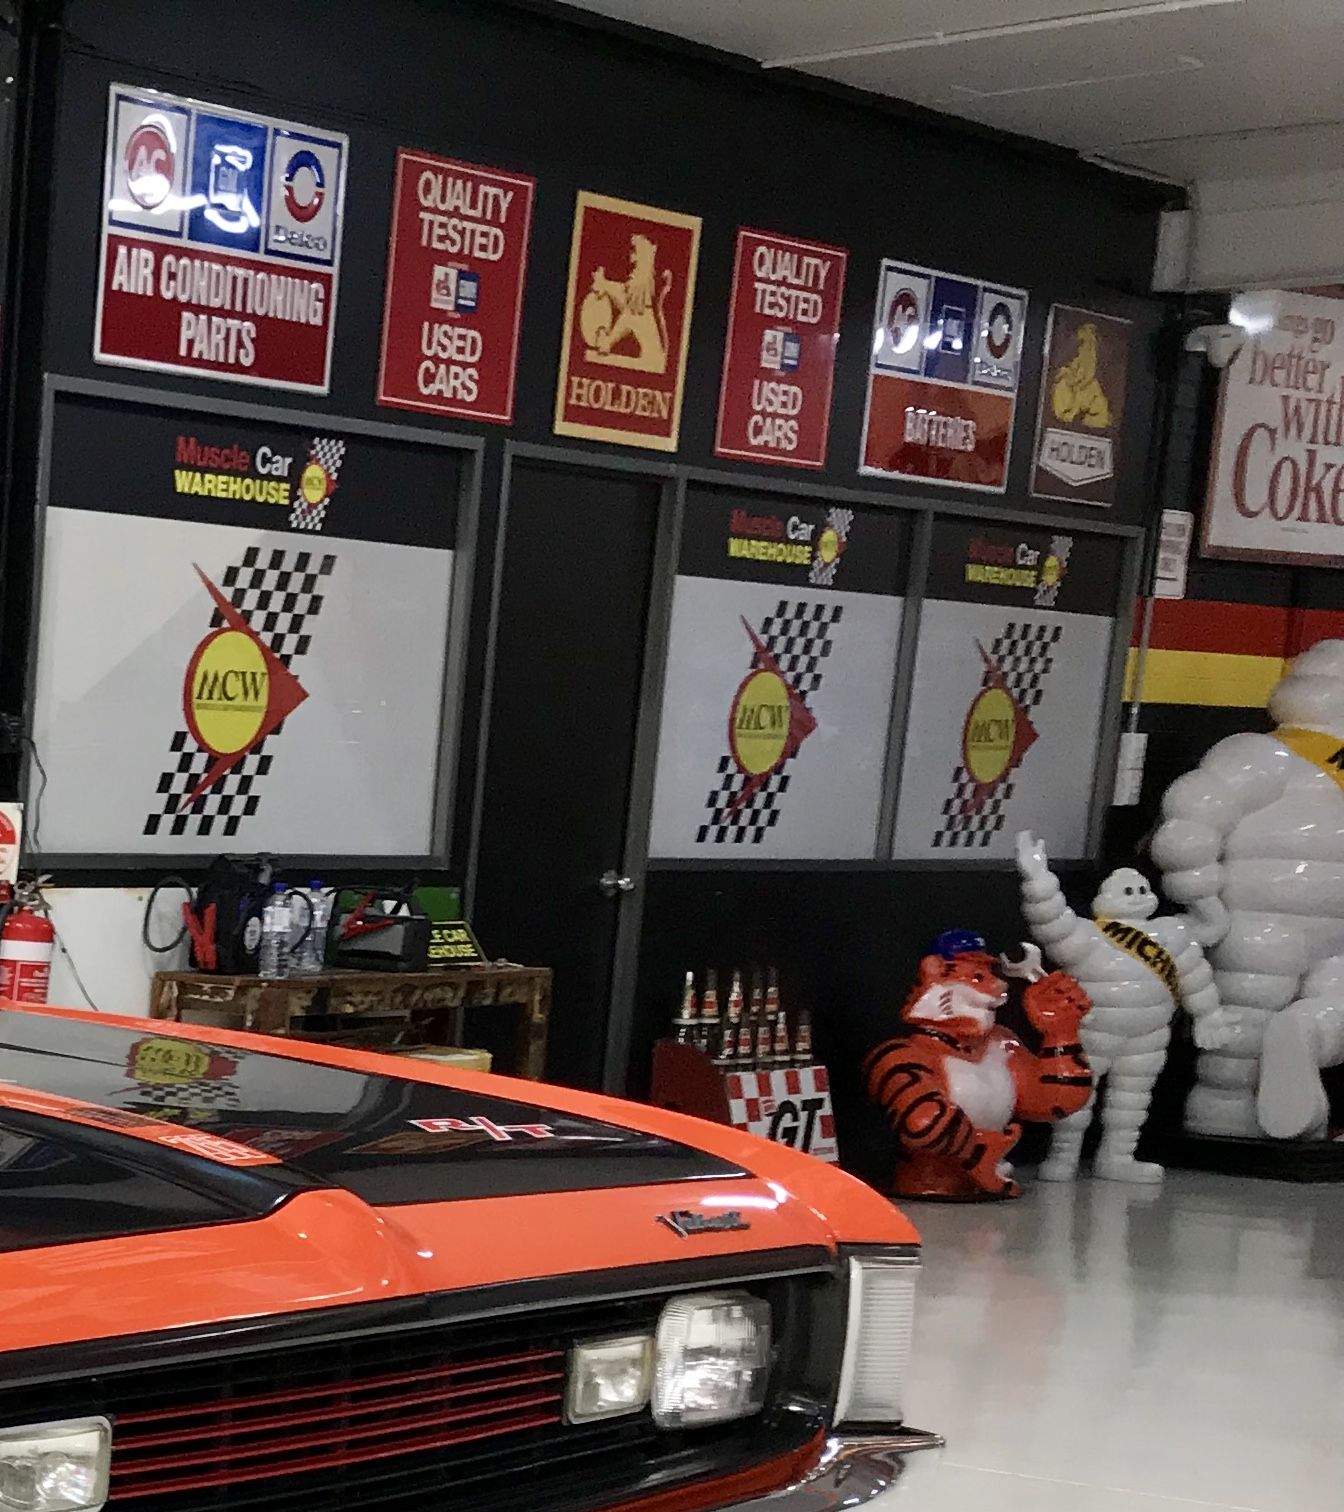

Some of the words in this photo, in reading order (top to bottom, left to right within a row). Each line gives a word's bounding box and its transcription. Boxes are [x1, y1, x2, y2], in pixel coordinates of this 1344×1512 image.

[418, 170, 513, 224] QUALITY
[419, 212, 505, 262] TESTED
[112, 245, 155, 296] AIR
[160, 254, 325, 326] CONDITIONING
[753, 246, 831, 290] QUALITY
[753, 282, 822, 324] TESTED
[179, 311, 257, 367] PARTS
[421, 321, 483, 363] USED
[417, 360, 479, 402] CARS
[569, 376, 672, 420] HOLDEN
[752, 379, 803, 416] USED
[748, 415, 799, 451] CARS
[175, 434, 250, 472] Muscle
[255, 446, 293, 477] Car
[174, 469, 291, 505] WAREHOUSE
[787, 516, 815, 541] Car
[195, 669, 268, 702] MCW
[736, 704, 790, 730] MCW
[407, 1116, 556, 1141] R/T
[765, 1098, 825, 1154] GT
